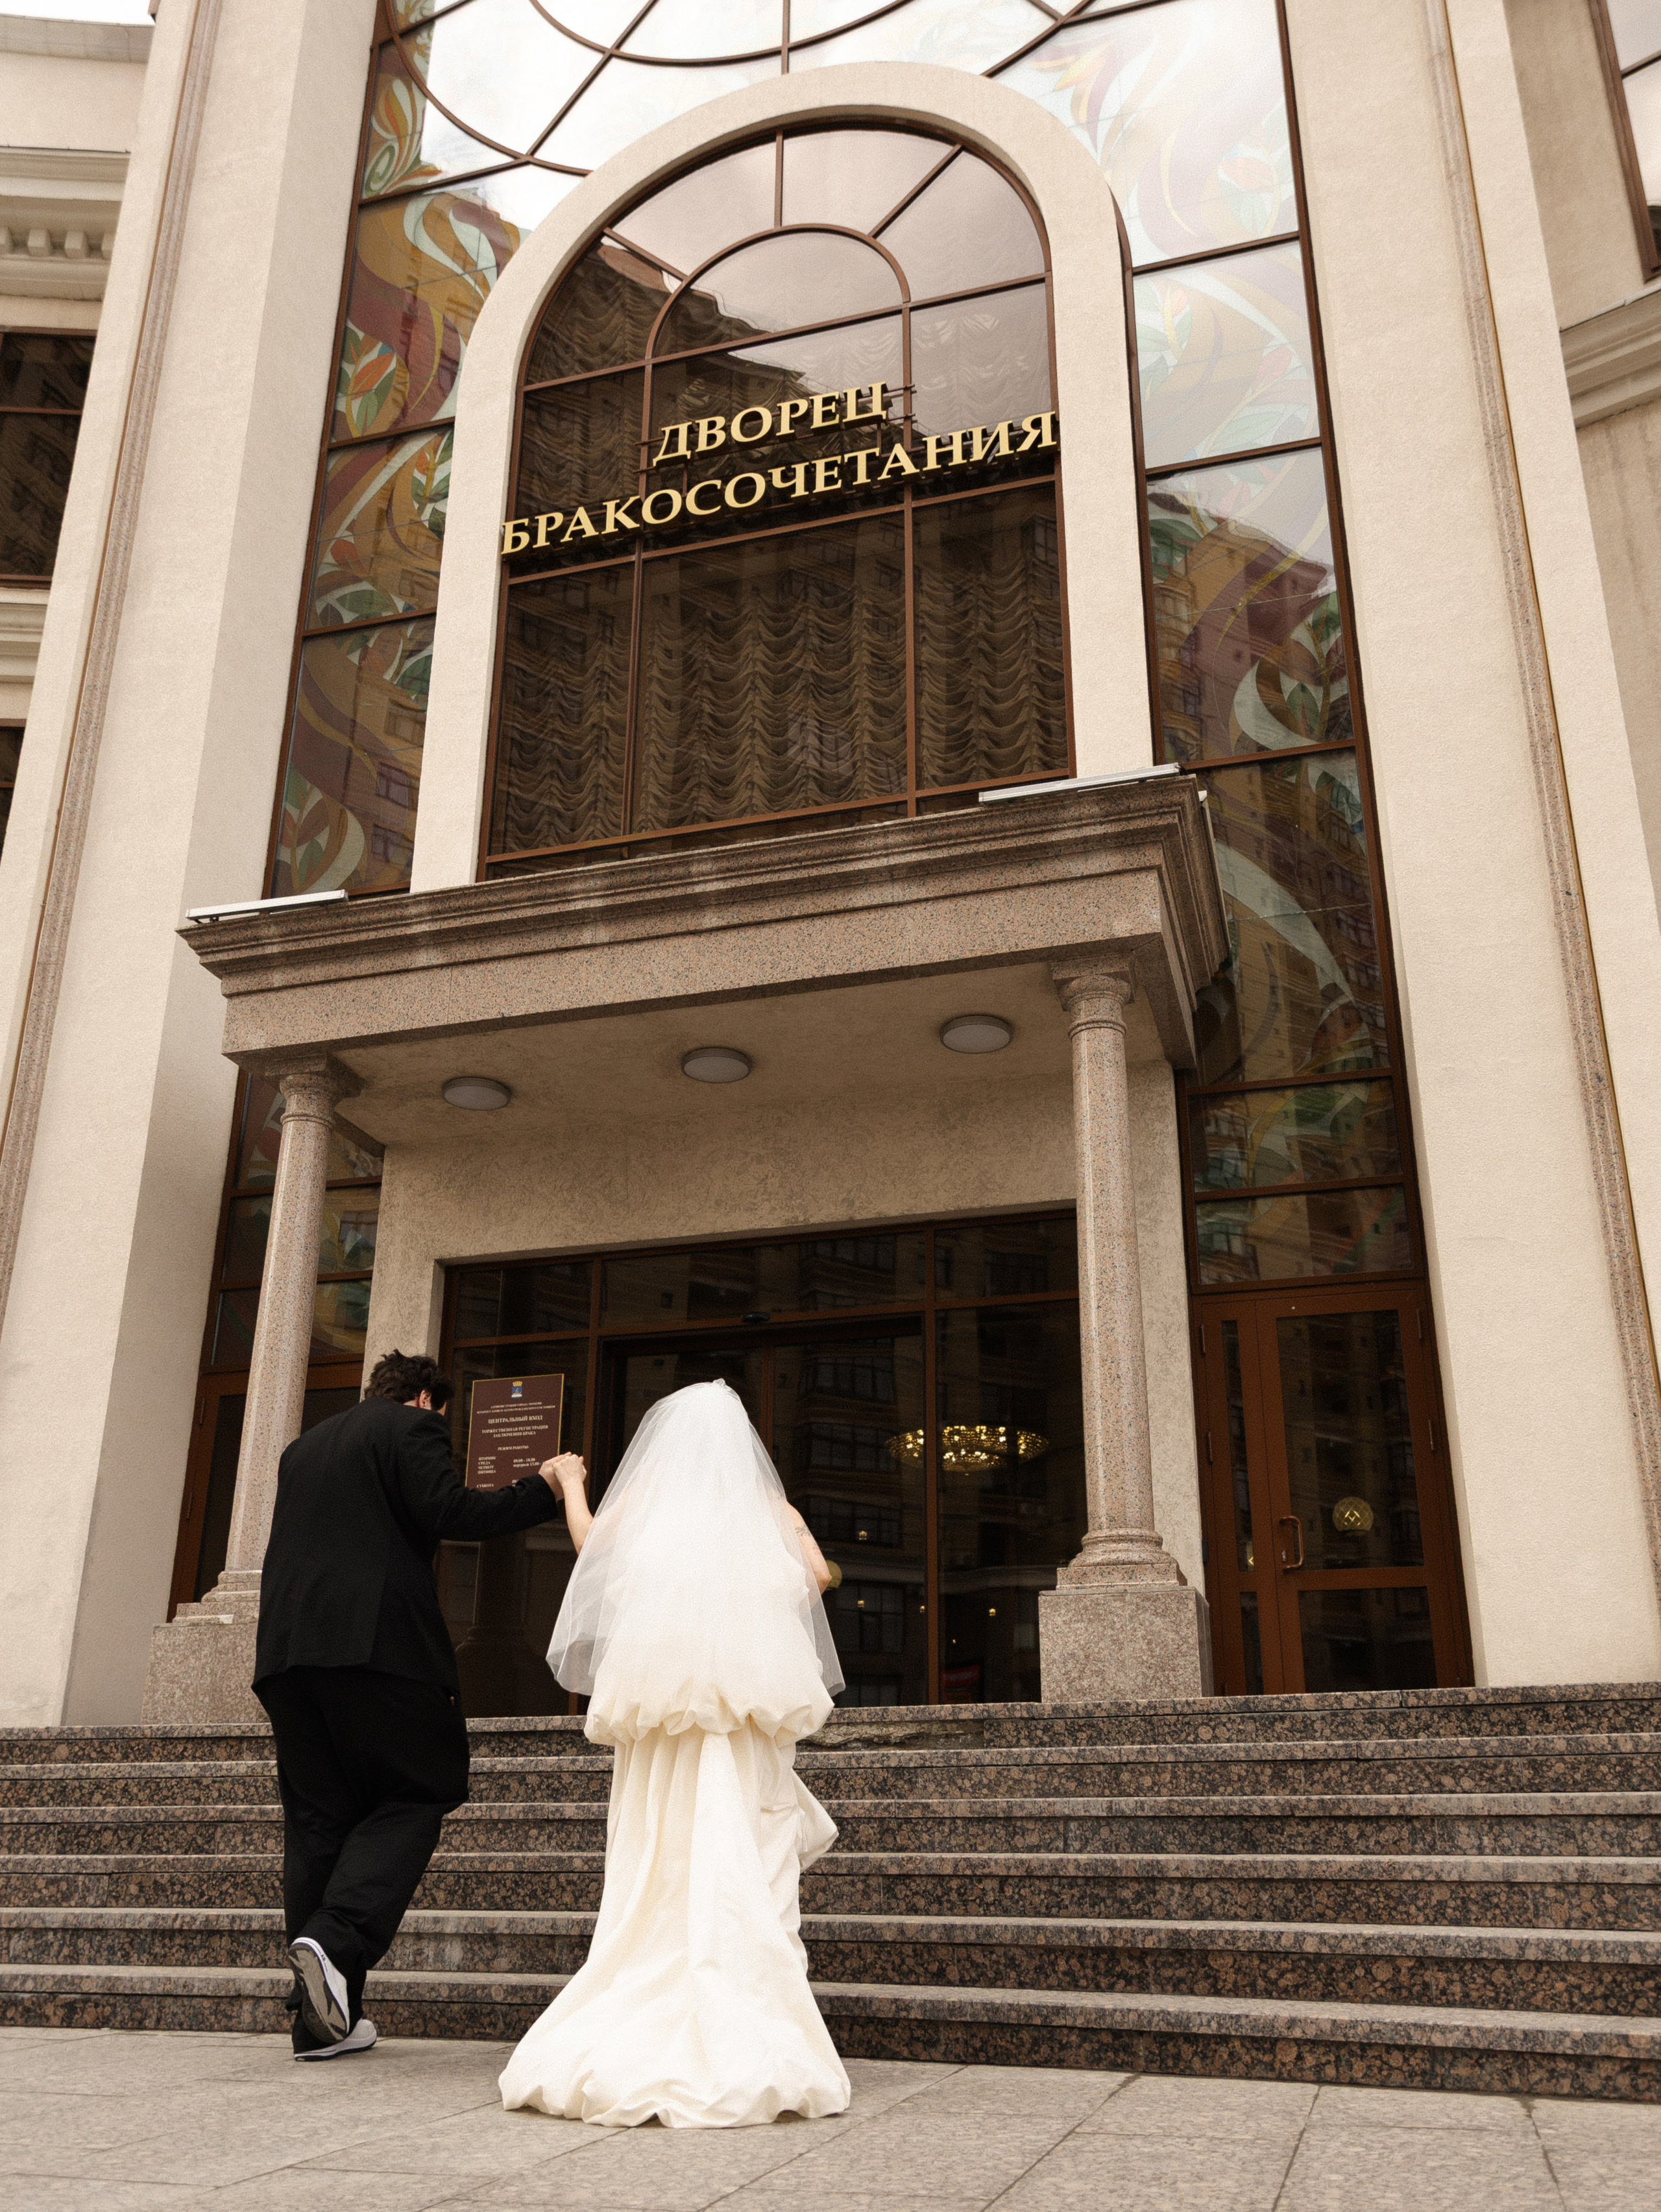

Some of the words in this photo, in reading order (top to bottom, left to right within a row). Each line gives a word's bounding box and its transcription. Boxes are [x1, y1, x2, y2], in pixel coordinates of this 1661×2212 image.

[652, 381, 887, 467] ДВОРЕЦ
[501, 411, 1058, 555] БРАКОСОЧЕТАНИЯ
[488, 1415, 528, 1424] ЦЕНТРАЛЬНЫЙ
